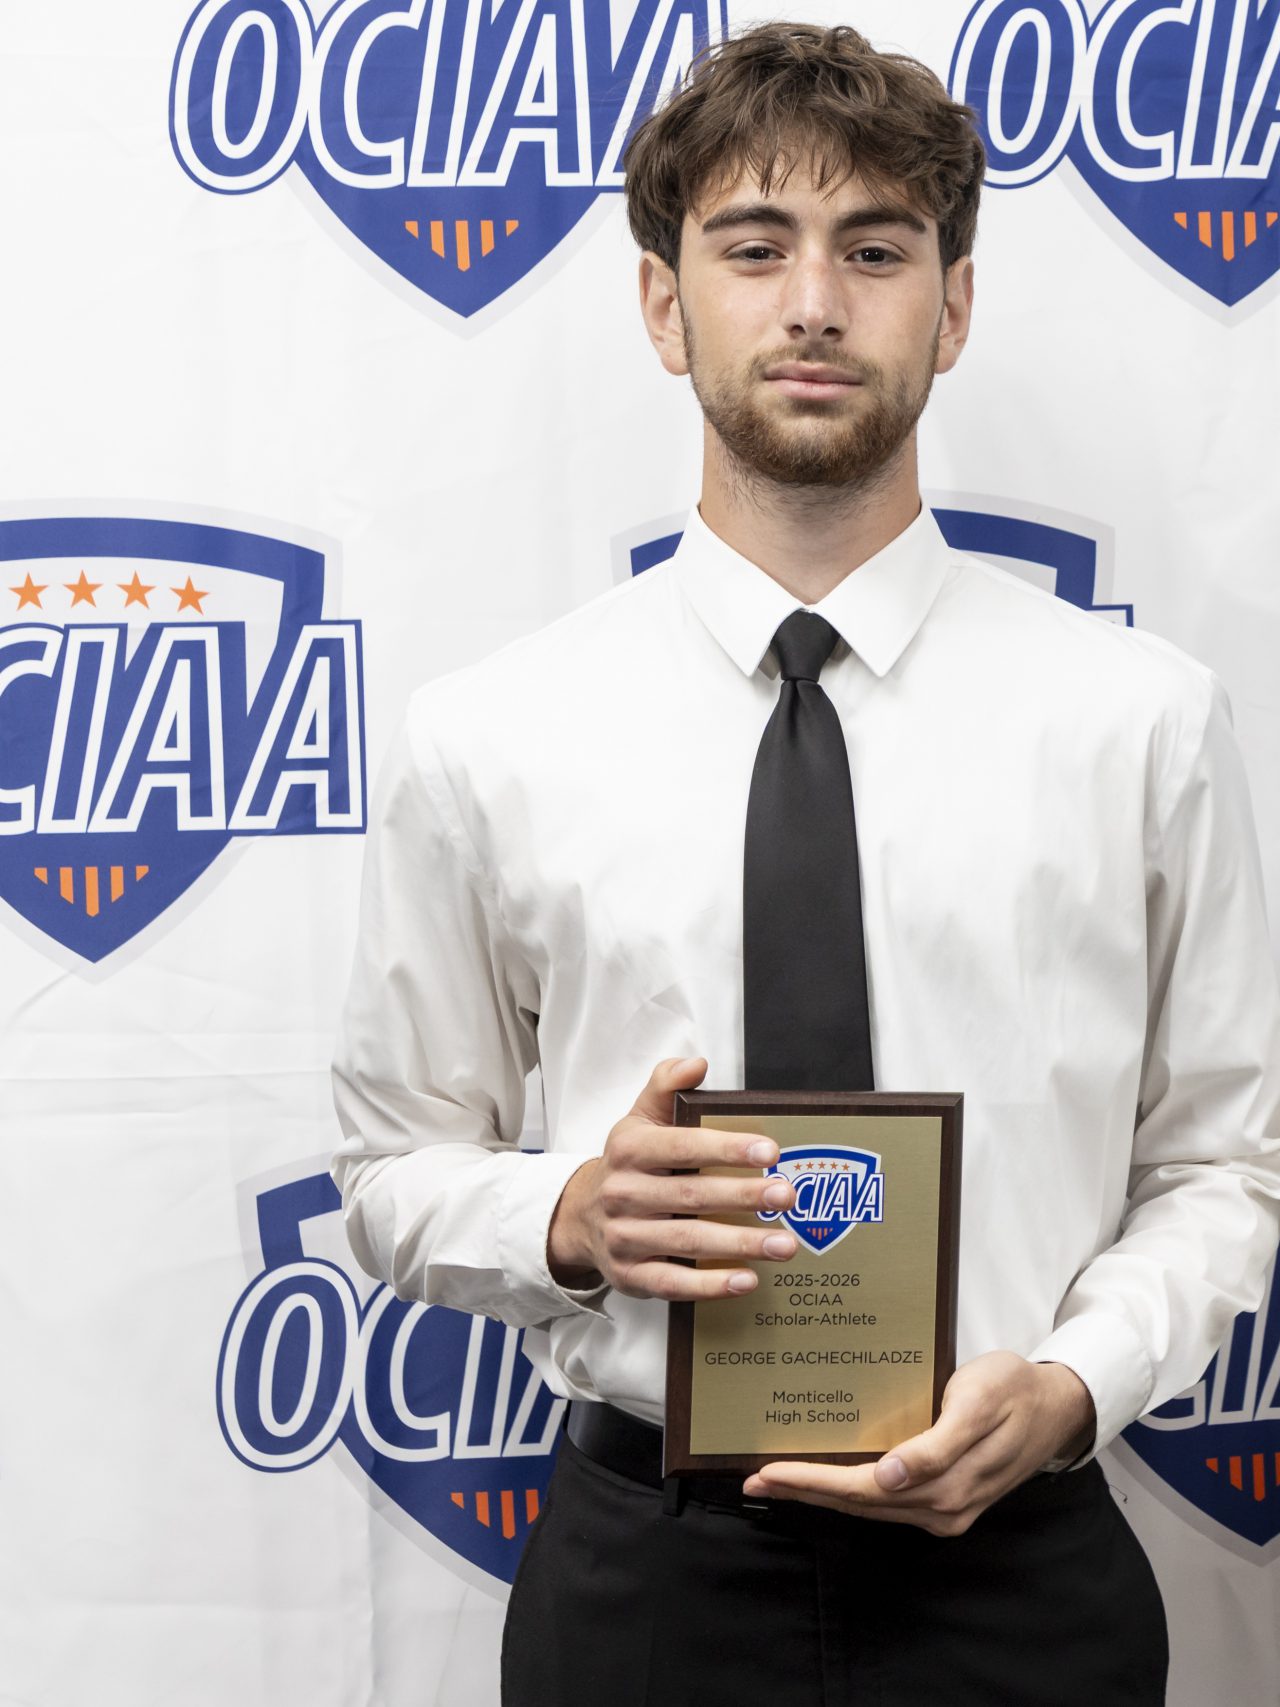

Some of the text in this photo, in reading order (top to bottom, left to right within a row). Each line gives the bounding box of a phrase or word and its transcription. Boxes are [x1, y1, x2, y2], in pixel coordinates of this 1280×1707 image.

[0, 619, 367, 835] CIAA
[774, 1274, 860, 1286] 2025-2026
[790, 1294, 843, 1306] OCIAA
[755, 1313, 876, 1325] Scholar-Athlete
[705, 1351, 922, 1365] GEORGE GACHECHILADZE
[773, 1390, 853, 1403] Monticello
[766, 1409, 859, 1425] High School
